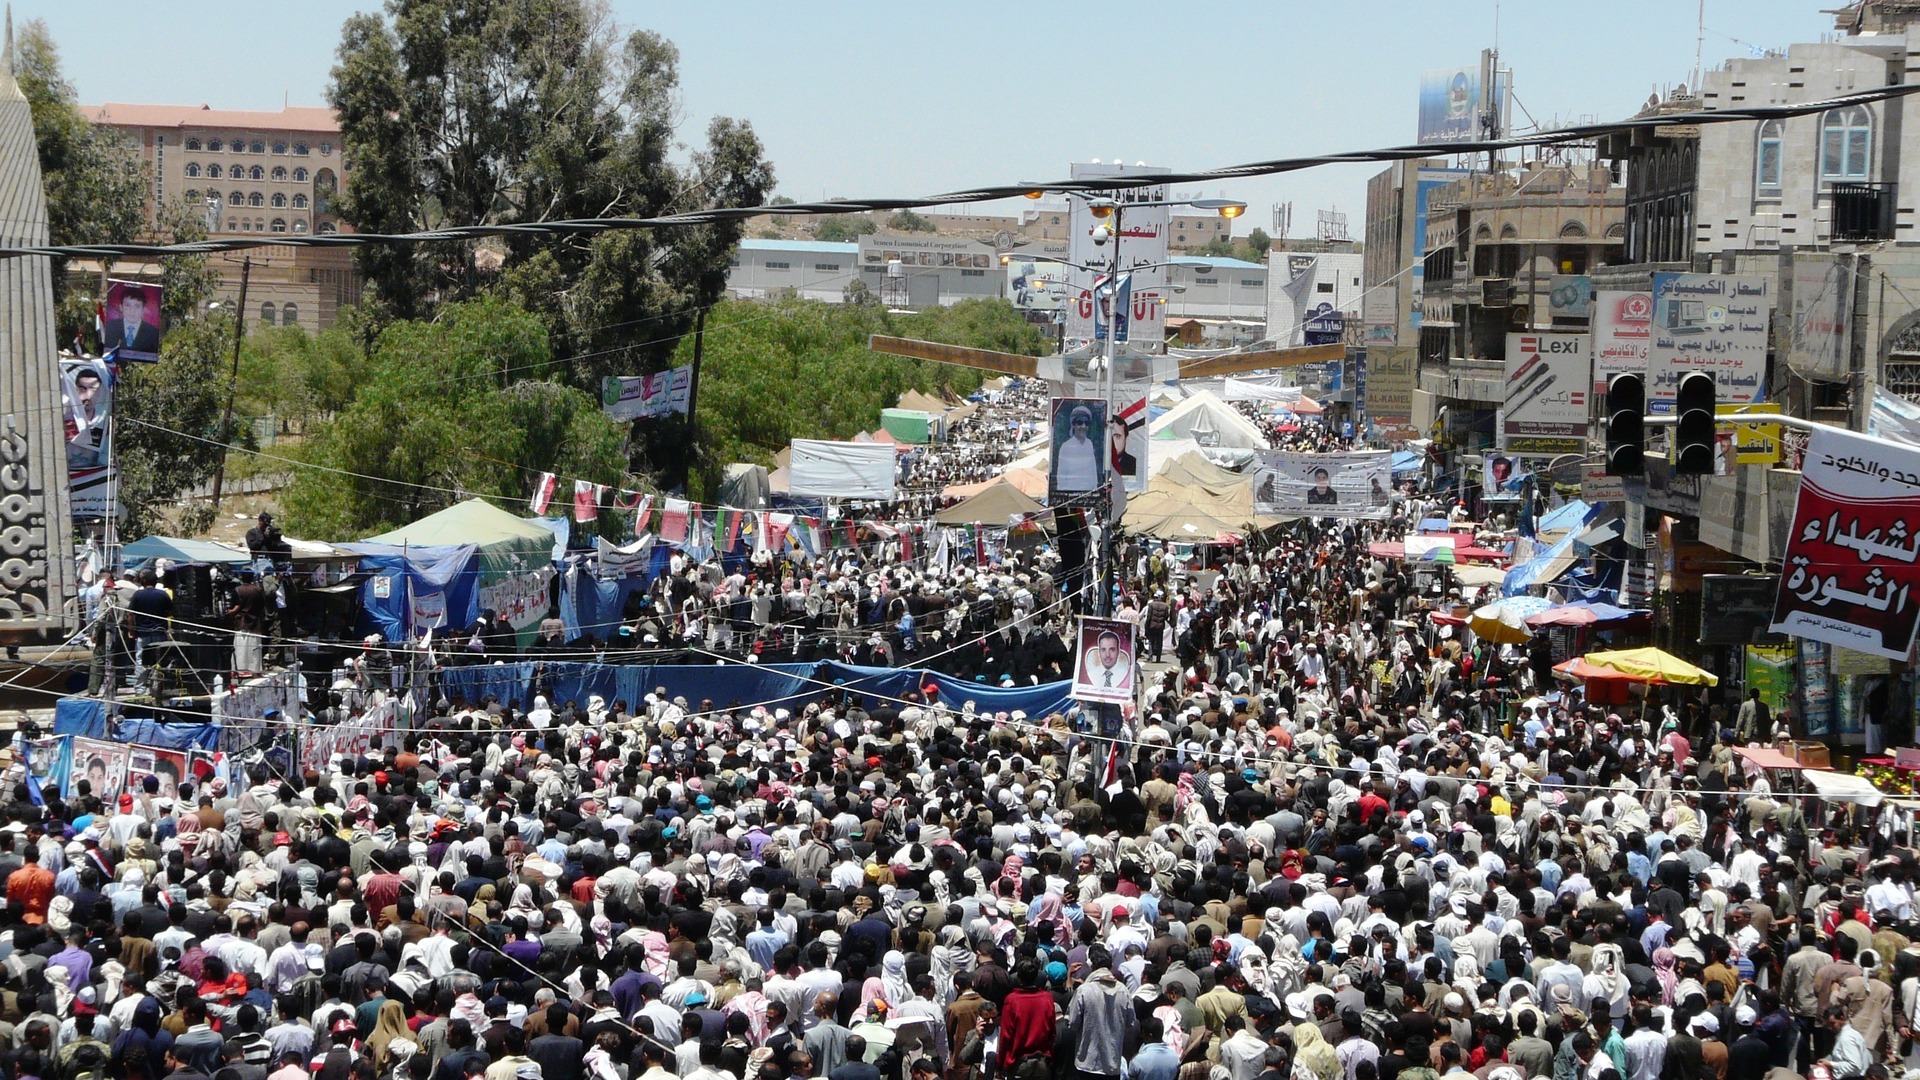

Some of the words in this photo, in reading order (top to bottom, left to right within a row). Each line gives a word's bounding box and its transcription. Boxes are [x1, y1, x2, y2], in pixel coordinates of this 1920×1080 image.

[1658, 278, 1726, 298] الكمبيوتر
[1728, 278, 1767, 298] أسعار
[1727, 303, 1757, 317] لدينا
[1538, 337, 1579, 354] Lexi
[1717, 369, 1758, 390] لصيانة
[621, 385, 638, 396] اليمن
[1821, 454, 1890, 482] والخلود
[1787, 555, 1910, 615] الثورة
[1796, 615, 1821, 626] الوطني
[1821, 620, 1852, 634] التضامن
